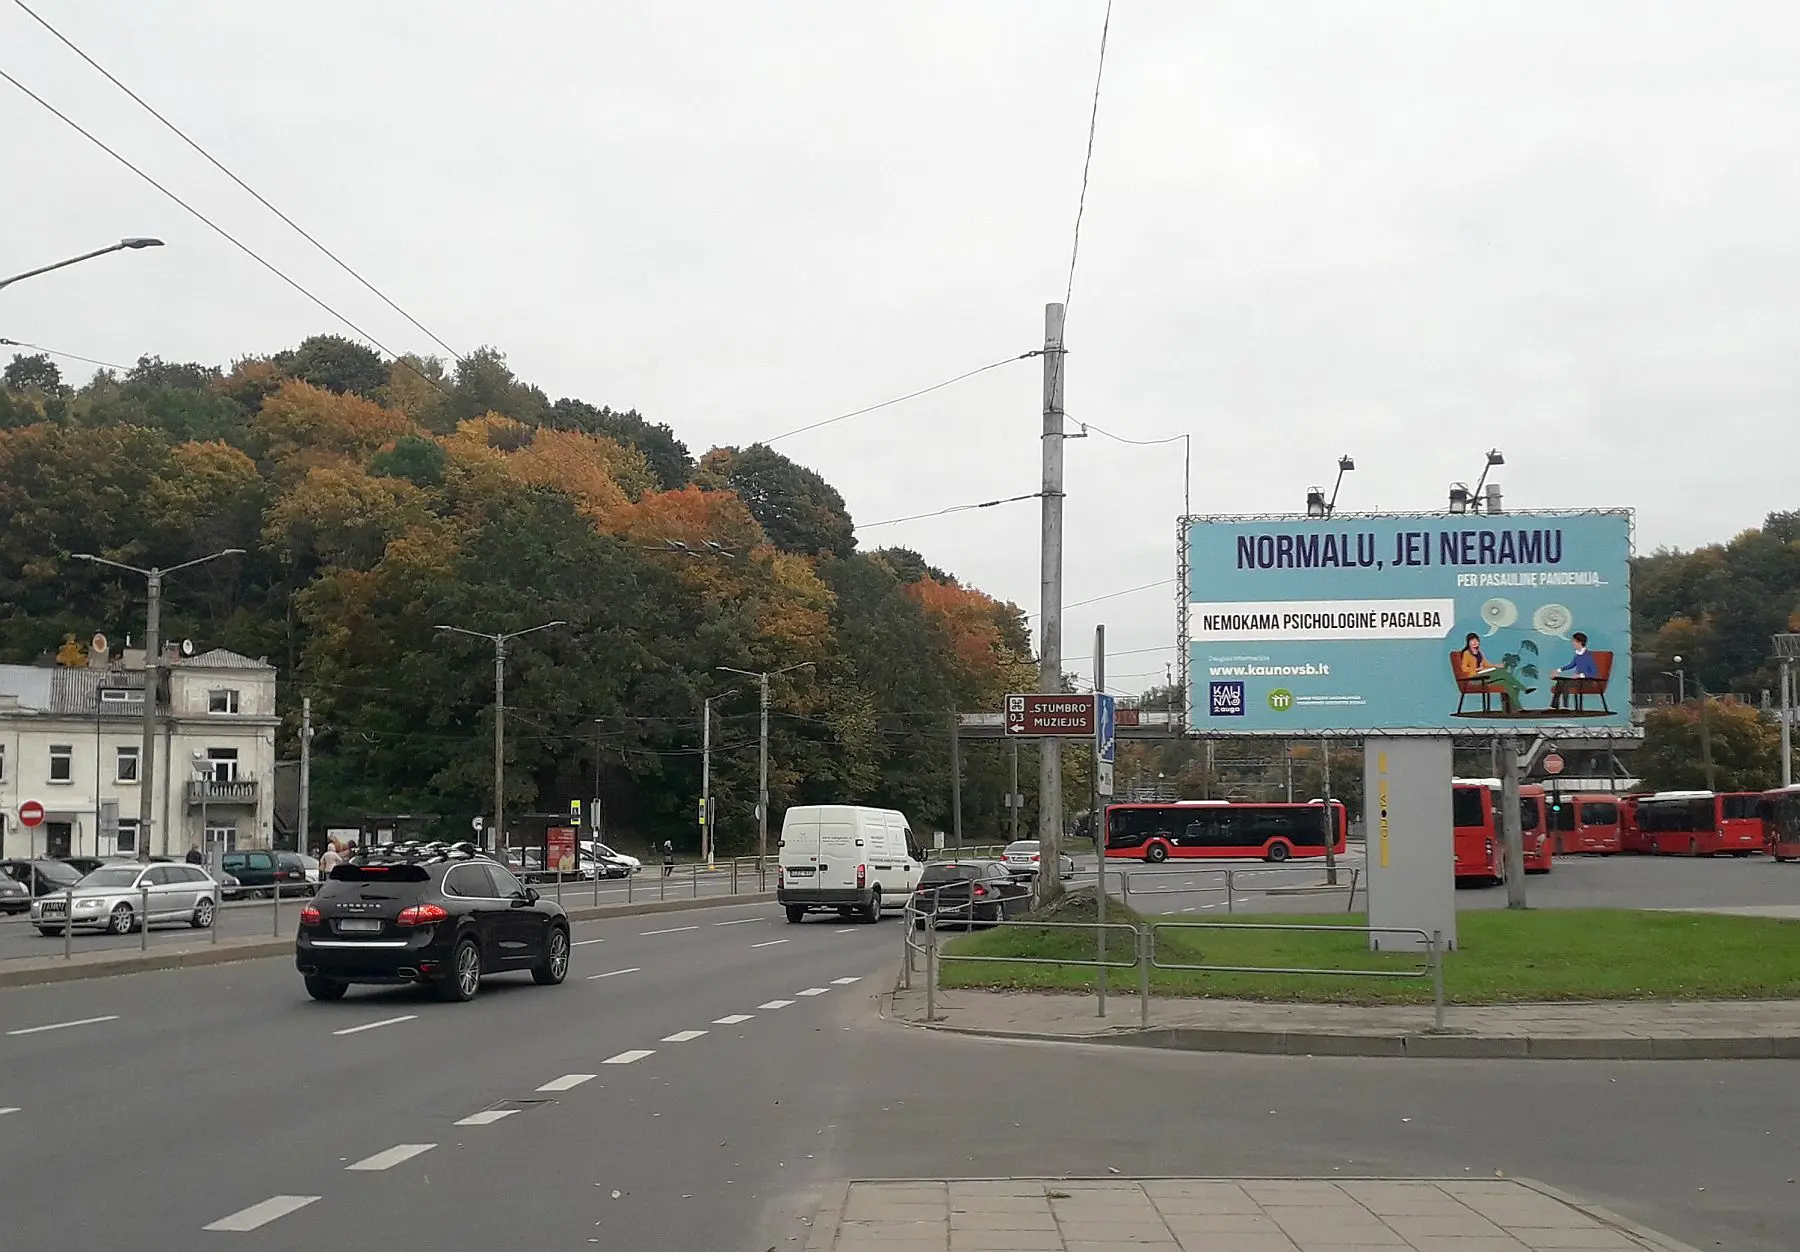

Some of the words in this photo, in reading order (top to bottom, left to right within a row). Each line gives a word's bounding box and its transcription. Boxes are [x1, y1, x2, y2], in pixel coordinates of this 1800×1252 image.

[1236, 534, 1385, 571] NORMALU,
[1392, 532, 1430, 566] JEI
[1440, 529, 1562, 566] NERAMU
[1457, 573, 1478, 587] PER
[1203, 614, 1280, 631] NEMOKAMA
[1283, 610, 1377, 629] PSICHOLOGINĖ
[1381, 611, 1442, 628] PAGALBA
[1208, 664, 1330, 676] www.kaunovsb.lt
[1220, 706, 1241, 714] auga
[1034, 718, 1087, 727] MUZIEJUS
